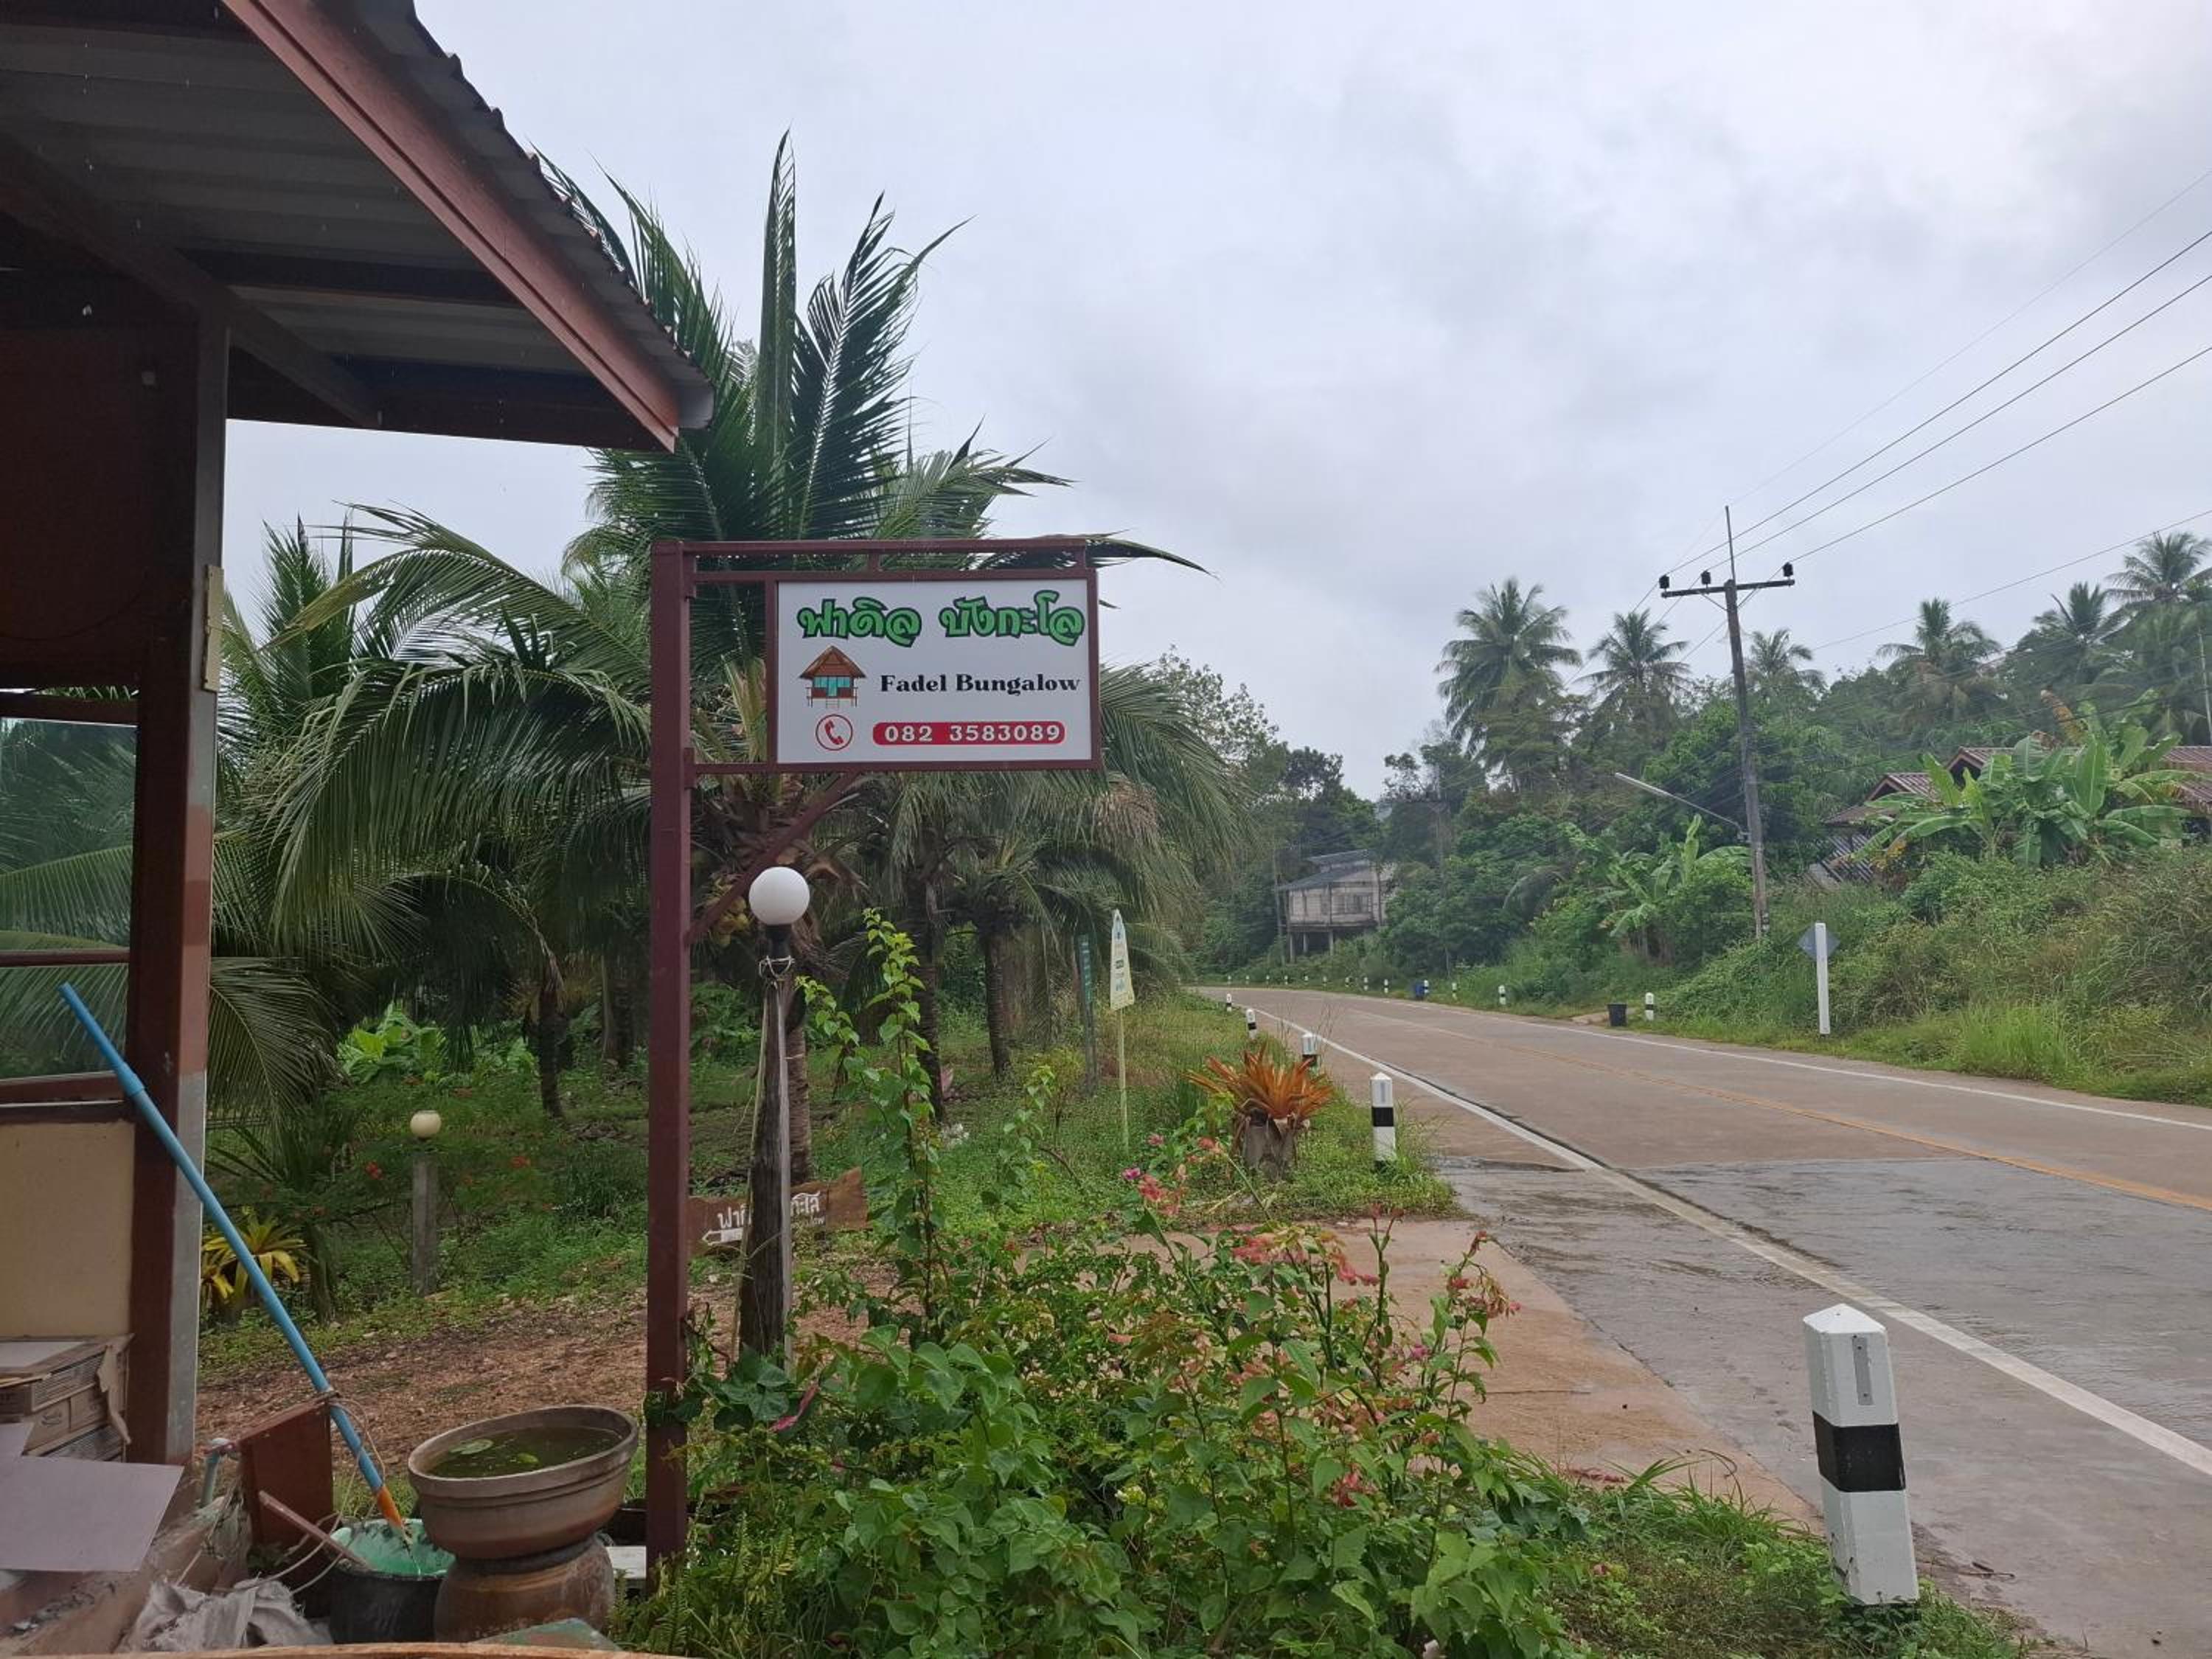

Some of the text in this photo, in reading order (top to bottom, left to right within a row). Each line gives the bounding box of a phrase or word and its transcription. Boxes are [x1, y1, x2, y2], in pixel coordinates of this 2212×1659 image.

[797, 590, 1085, 647] ฟาดิล บังกะโล
[880, 673, 1081, 697] Fadel Bungalow
[885, 724, 1060, 742] 082 3583089
